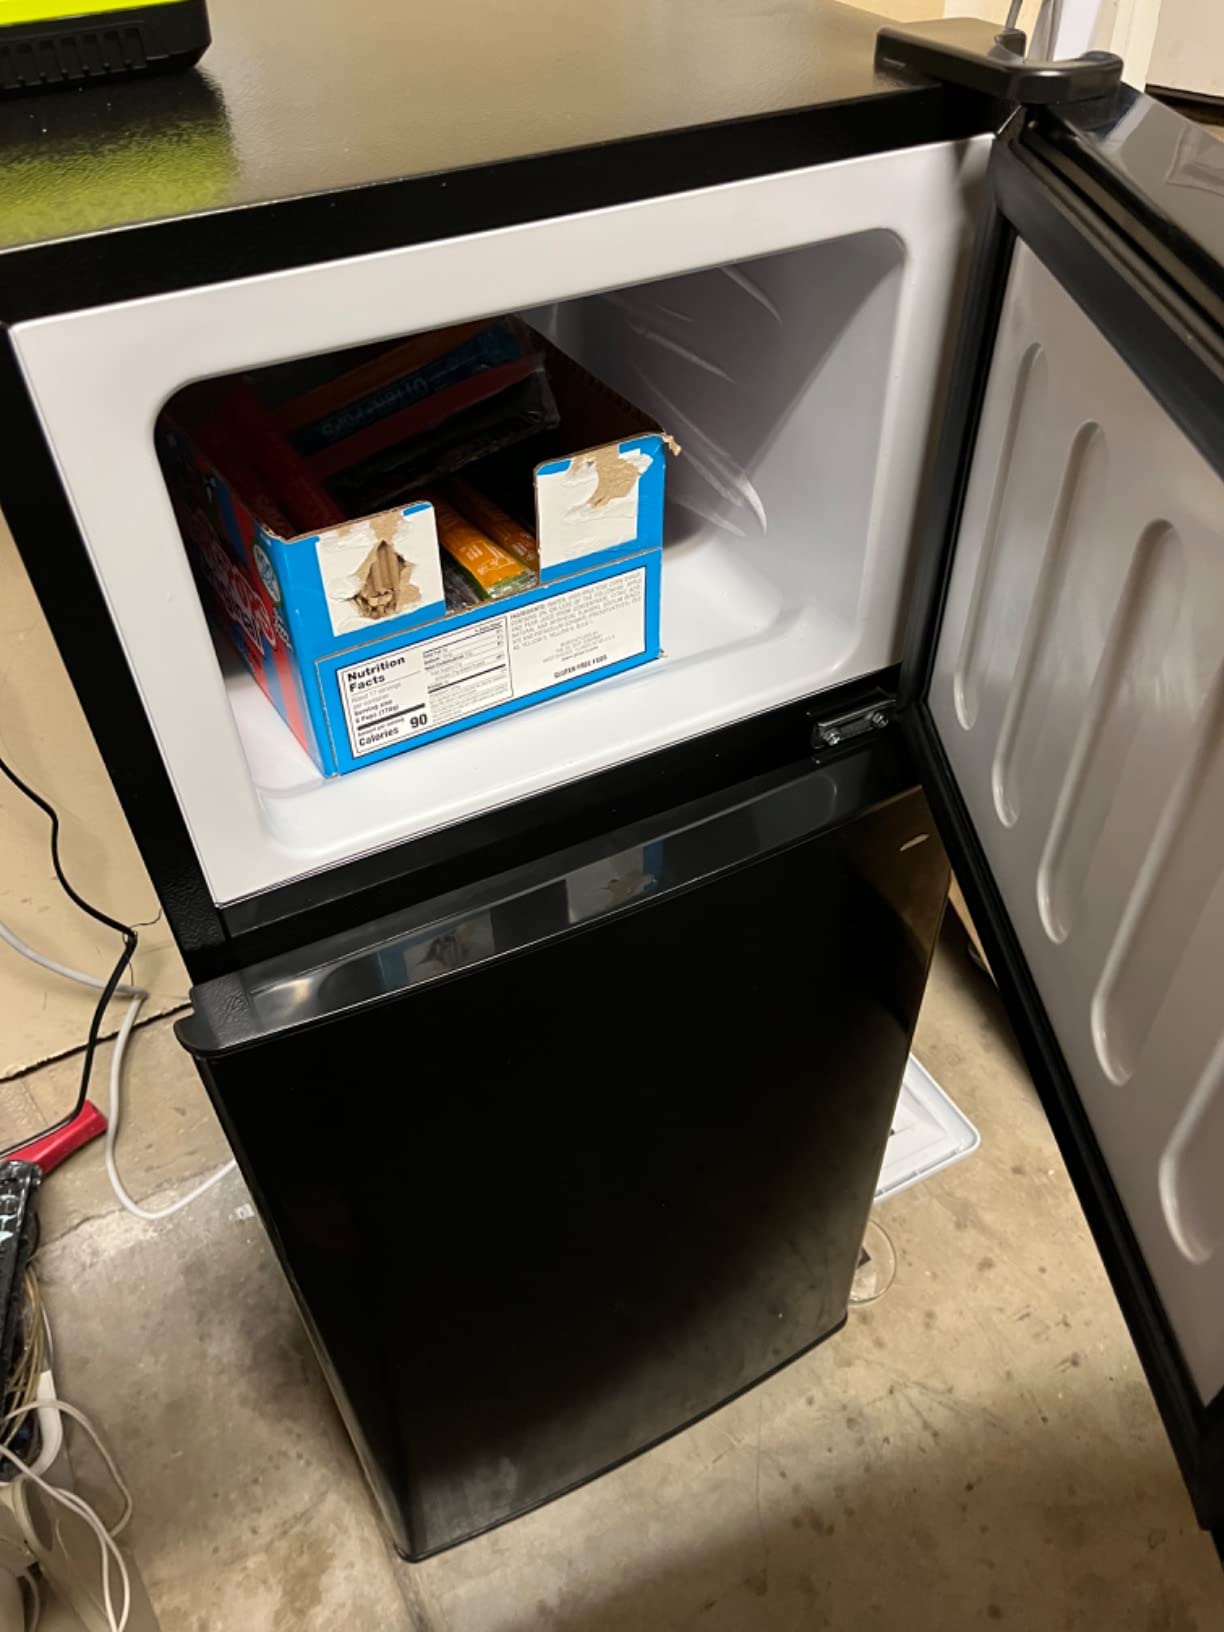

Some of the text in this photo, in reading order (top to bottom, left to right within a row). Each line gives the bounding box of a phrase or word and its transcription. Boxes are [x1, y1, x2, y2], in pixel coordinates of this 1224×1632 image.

[347, 656, 406, 681] Nutrition
[349, 675, 385, 692] Facts
[359, 713, 428, 746] Calories 90
